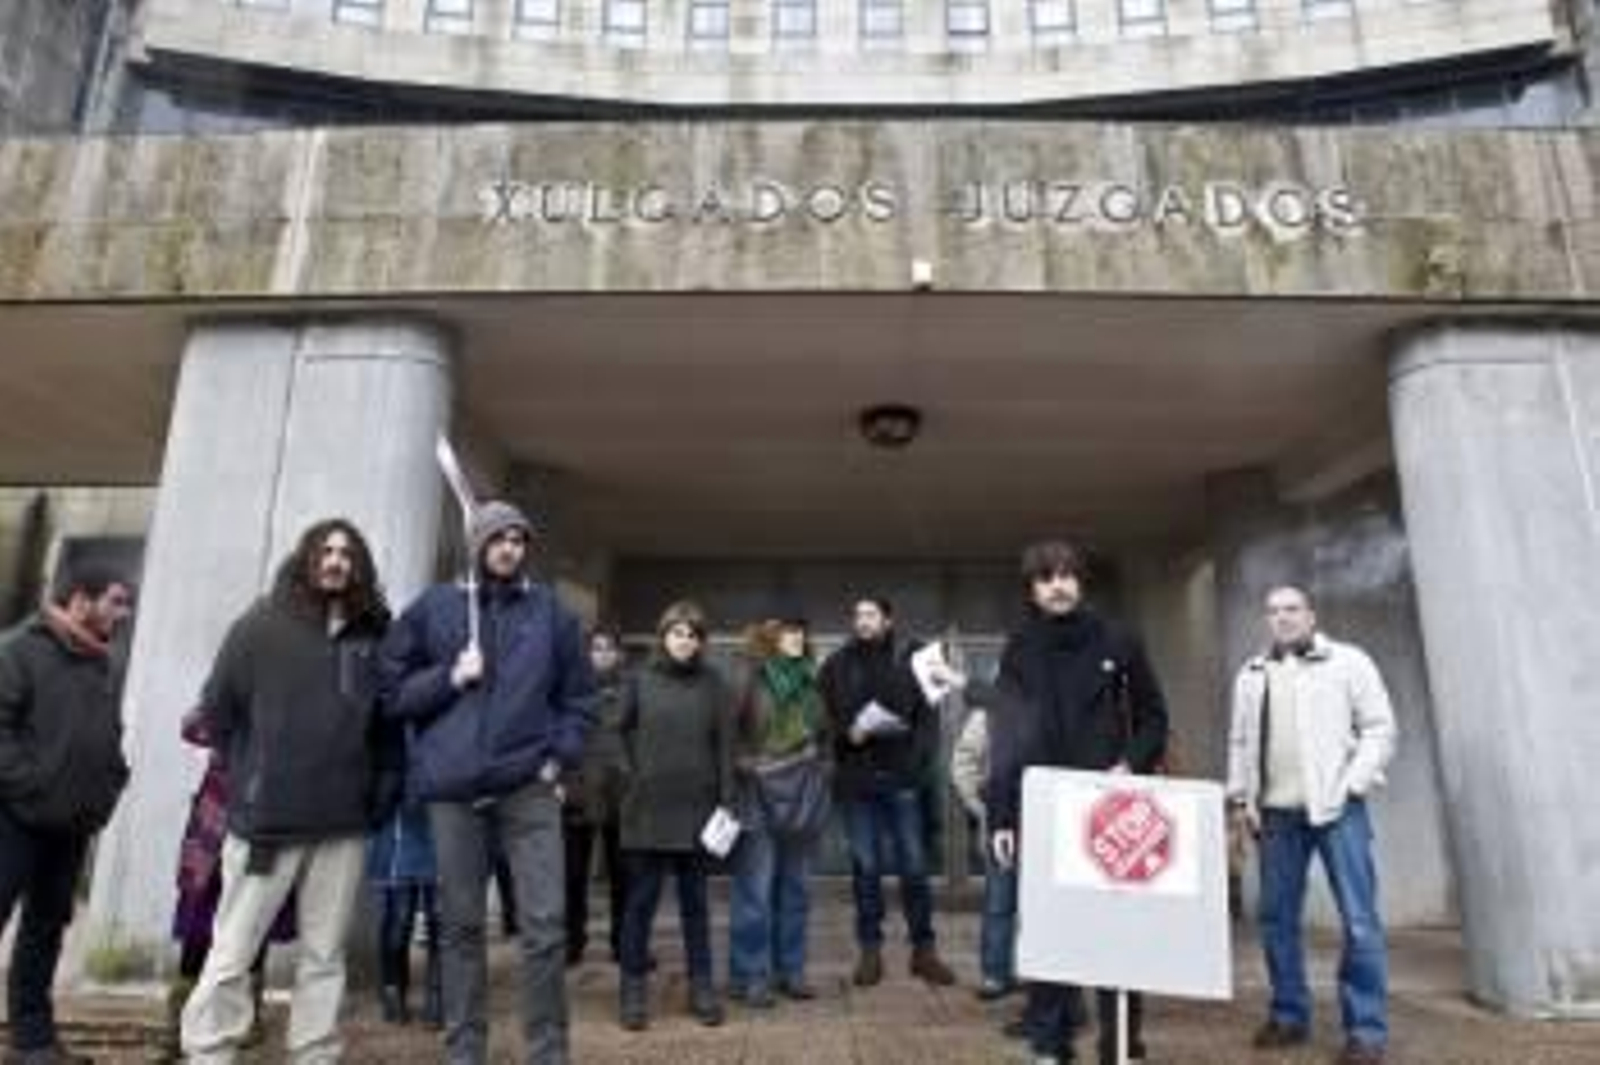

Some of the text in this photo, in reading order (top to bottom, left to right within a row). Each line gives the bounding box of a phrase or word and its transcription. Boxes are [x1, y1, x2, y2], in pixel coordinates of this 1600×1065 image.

[481, 180, 1363, 236] XULGADOS JUZGADOS
[1093, 800, 1152, 864] STOP
